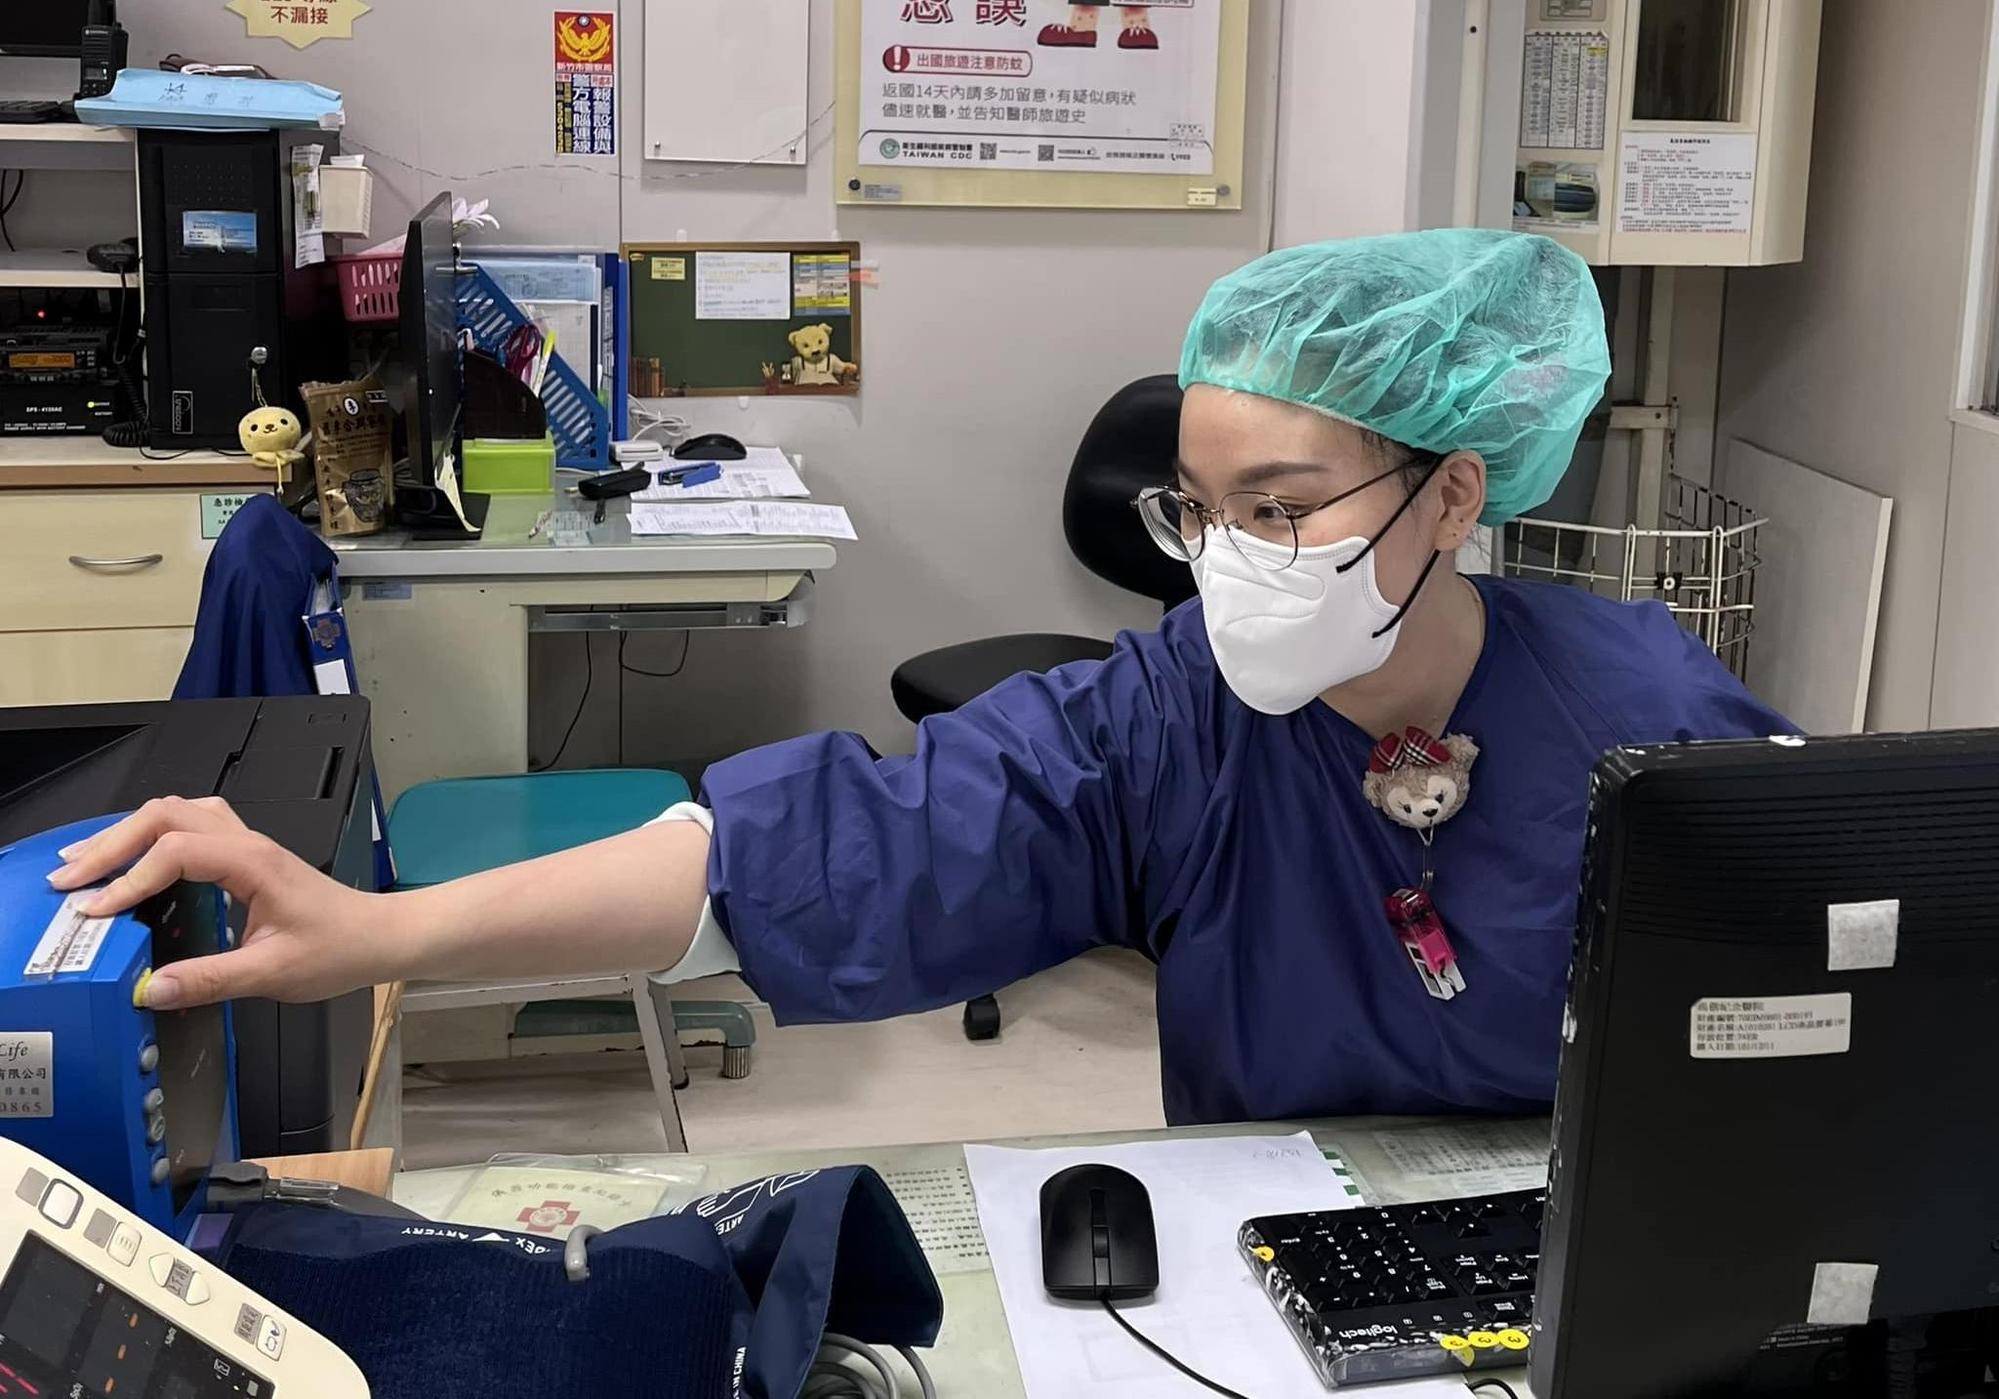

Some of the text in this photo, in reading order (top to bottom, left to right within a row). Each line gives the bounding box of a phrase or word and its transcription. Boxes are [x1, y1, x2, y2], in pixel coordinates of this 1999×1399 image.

[270, 5, 329, 25] 不漏接
[916, 52, 1024, 71] 出國旅遊注意防蚊
[715, 1213, 745, 1236] ARTE
[401, 1227, 551, 1255] DEX ARTERY
[1339, 1325, 1398, 1340] logitech
[733, 1346, 747, 1376] CHINA
